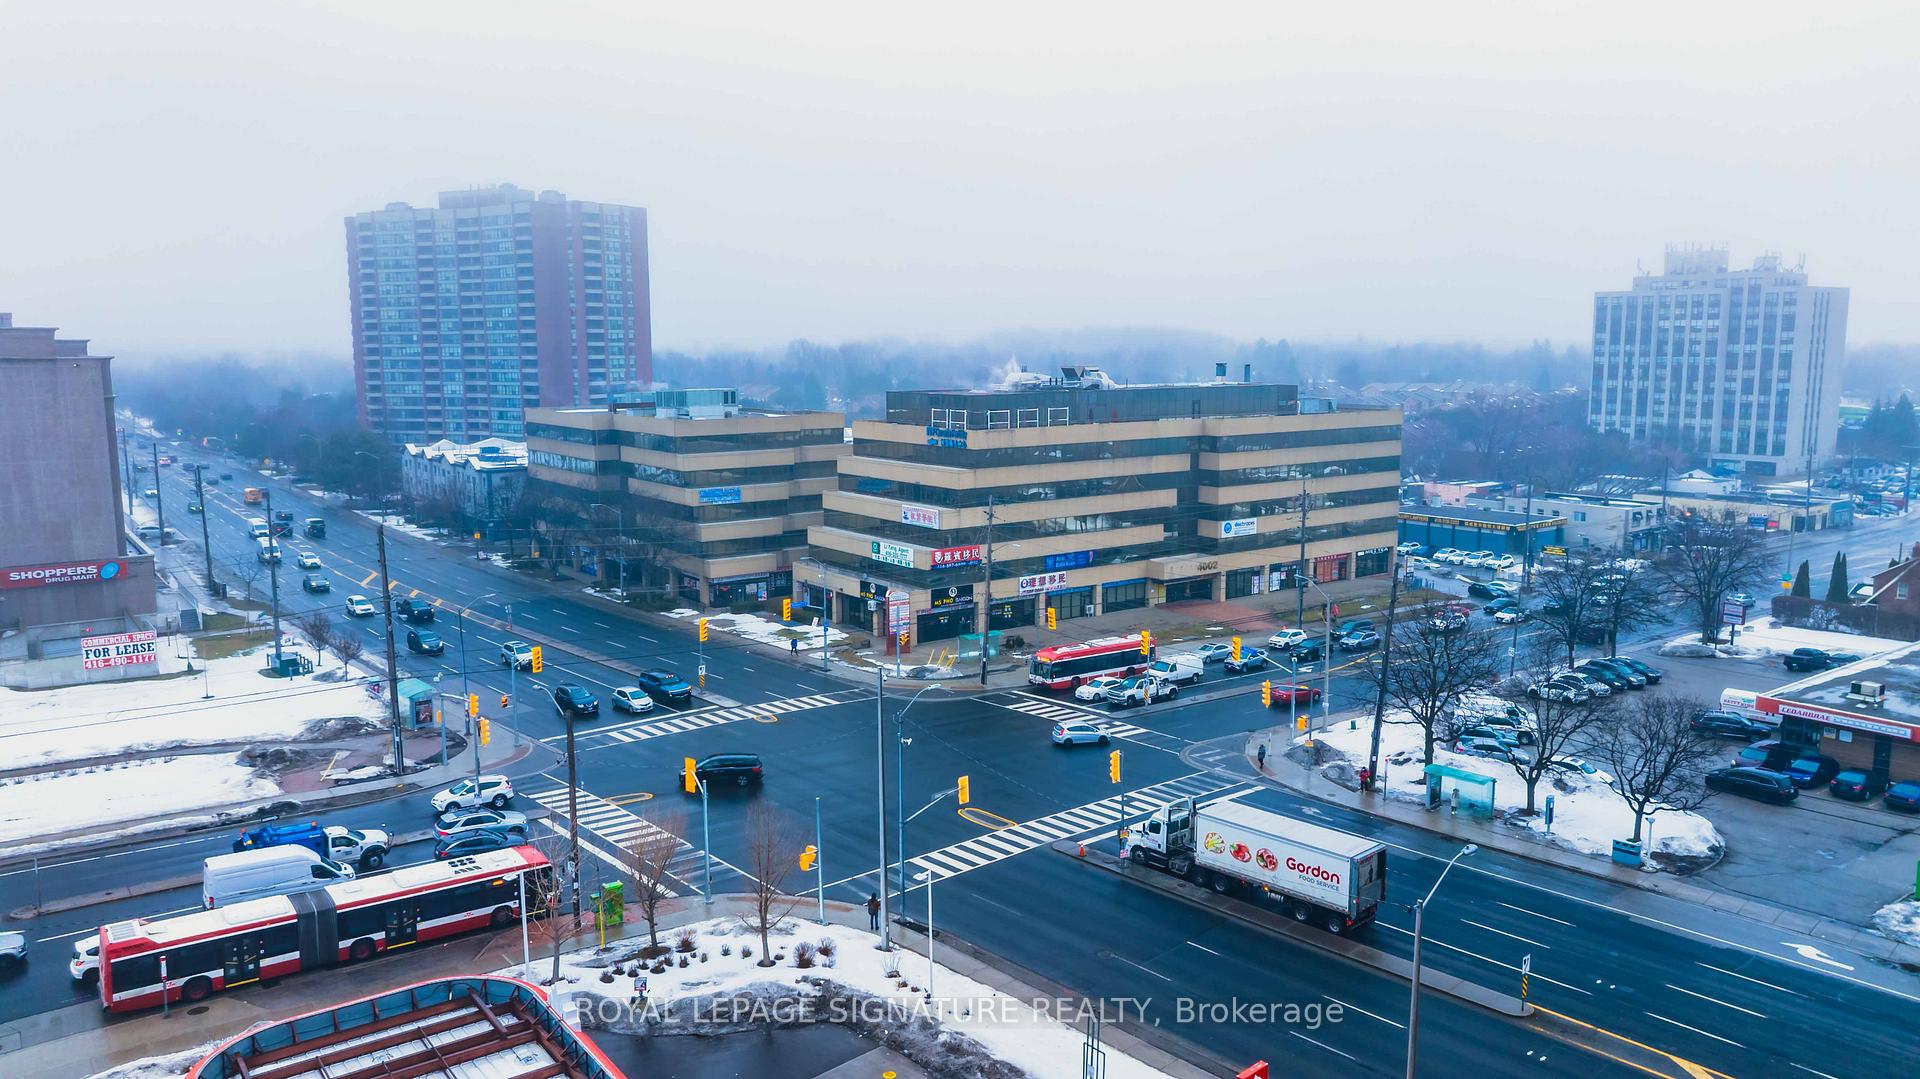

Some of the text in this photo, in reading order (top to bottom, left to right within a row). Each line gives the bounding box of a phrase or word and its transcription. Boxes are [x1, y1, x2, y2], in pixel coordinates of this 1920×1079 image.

[9, 565, 98, 581] SHOPPERS
[1197, 561, 1218, 571] 4002
[82, 631, 155, 648] COMMERCIAL SPACE
[84, 642, 155, 659] FOR LEASE
[85, 653, 156, 669] 416-490-1177
[1286, 857, 1340, 884] Gordon
[1298, 874, 1340, 891] FOOD SERVICE
